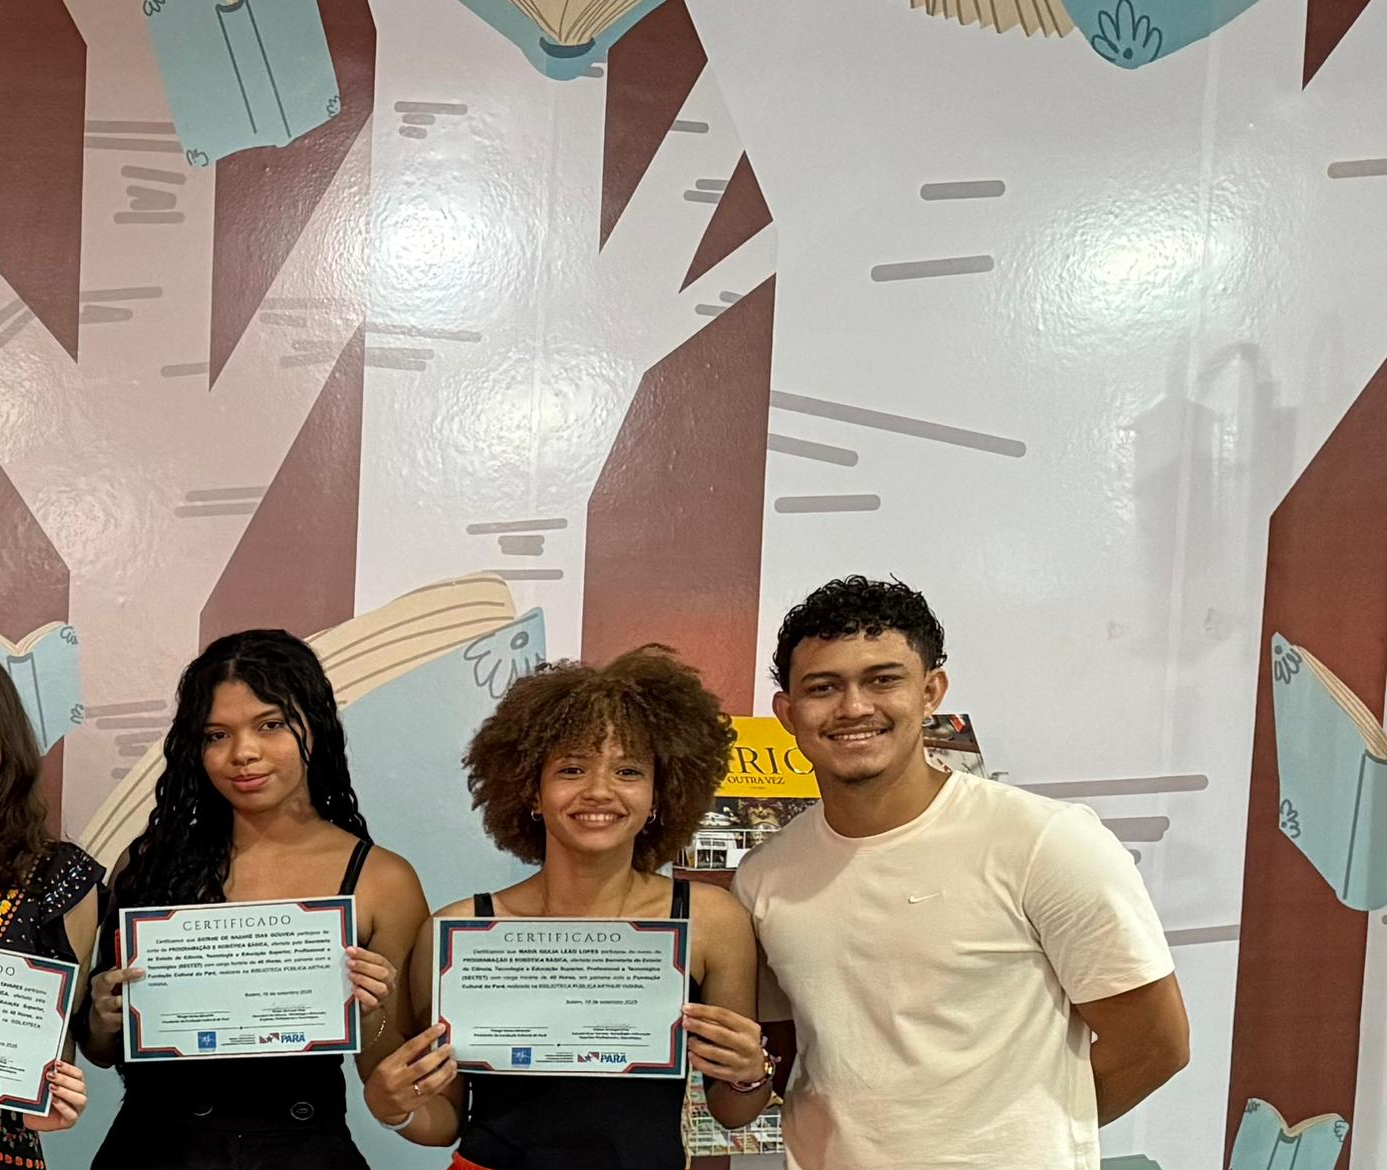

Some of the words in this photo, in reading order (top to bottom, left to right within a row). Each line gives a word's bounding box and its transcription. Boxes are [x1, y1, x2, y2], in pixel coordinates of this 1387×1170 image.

[733, 746, 814, 775] RIO
[727, 776, 764, 784] OUTRA
[764, 776, 786, 785] VEZ
[182, 914, 291, 931] CERTIFICADO
[504, 931, 620, 944] CERTIFICADO
